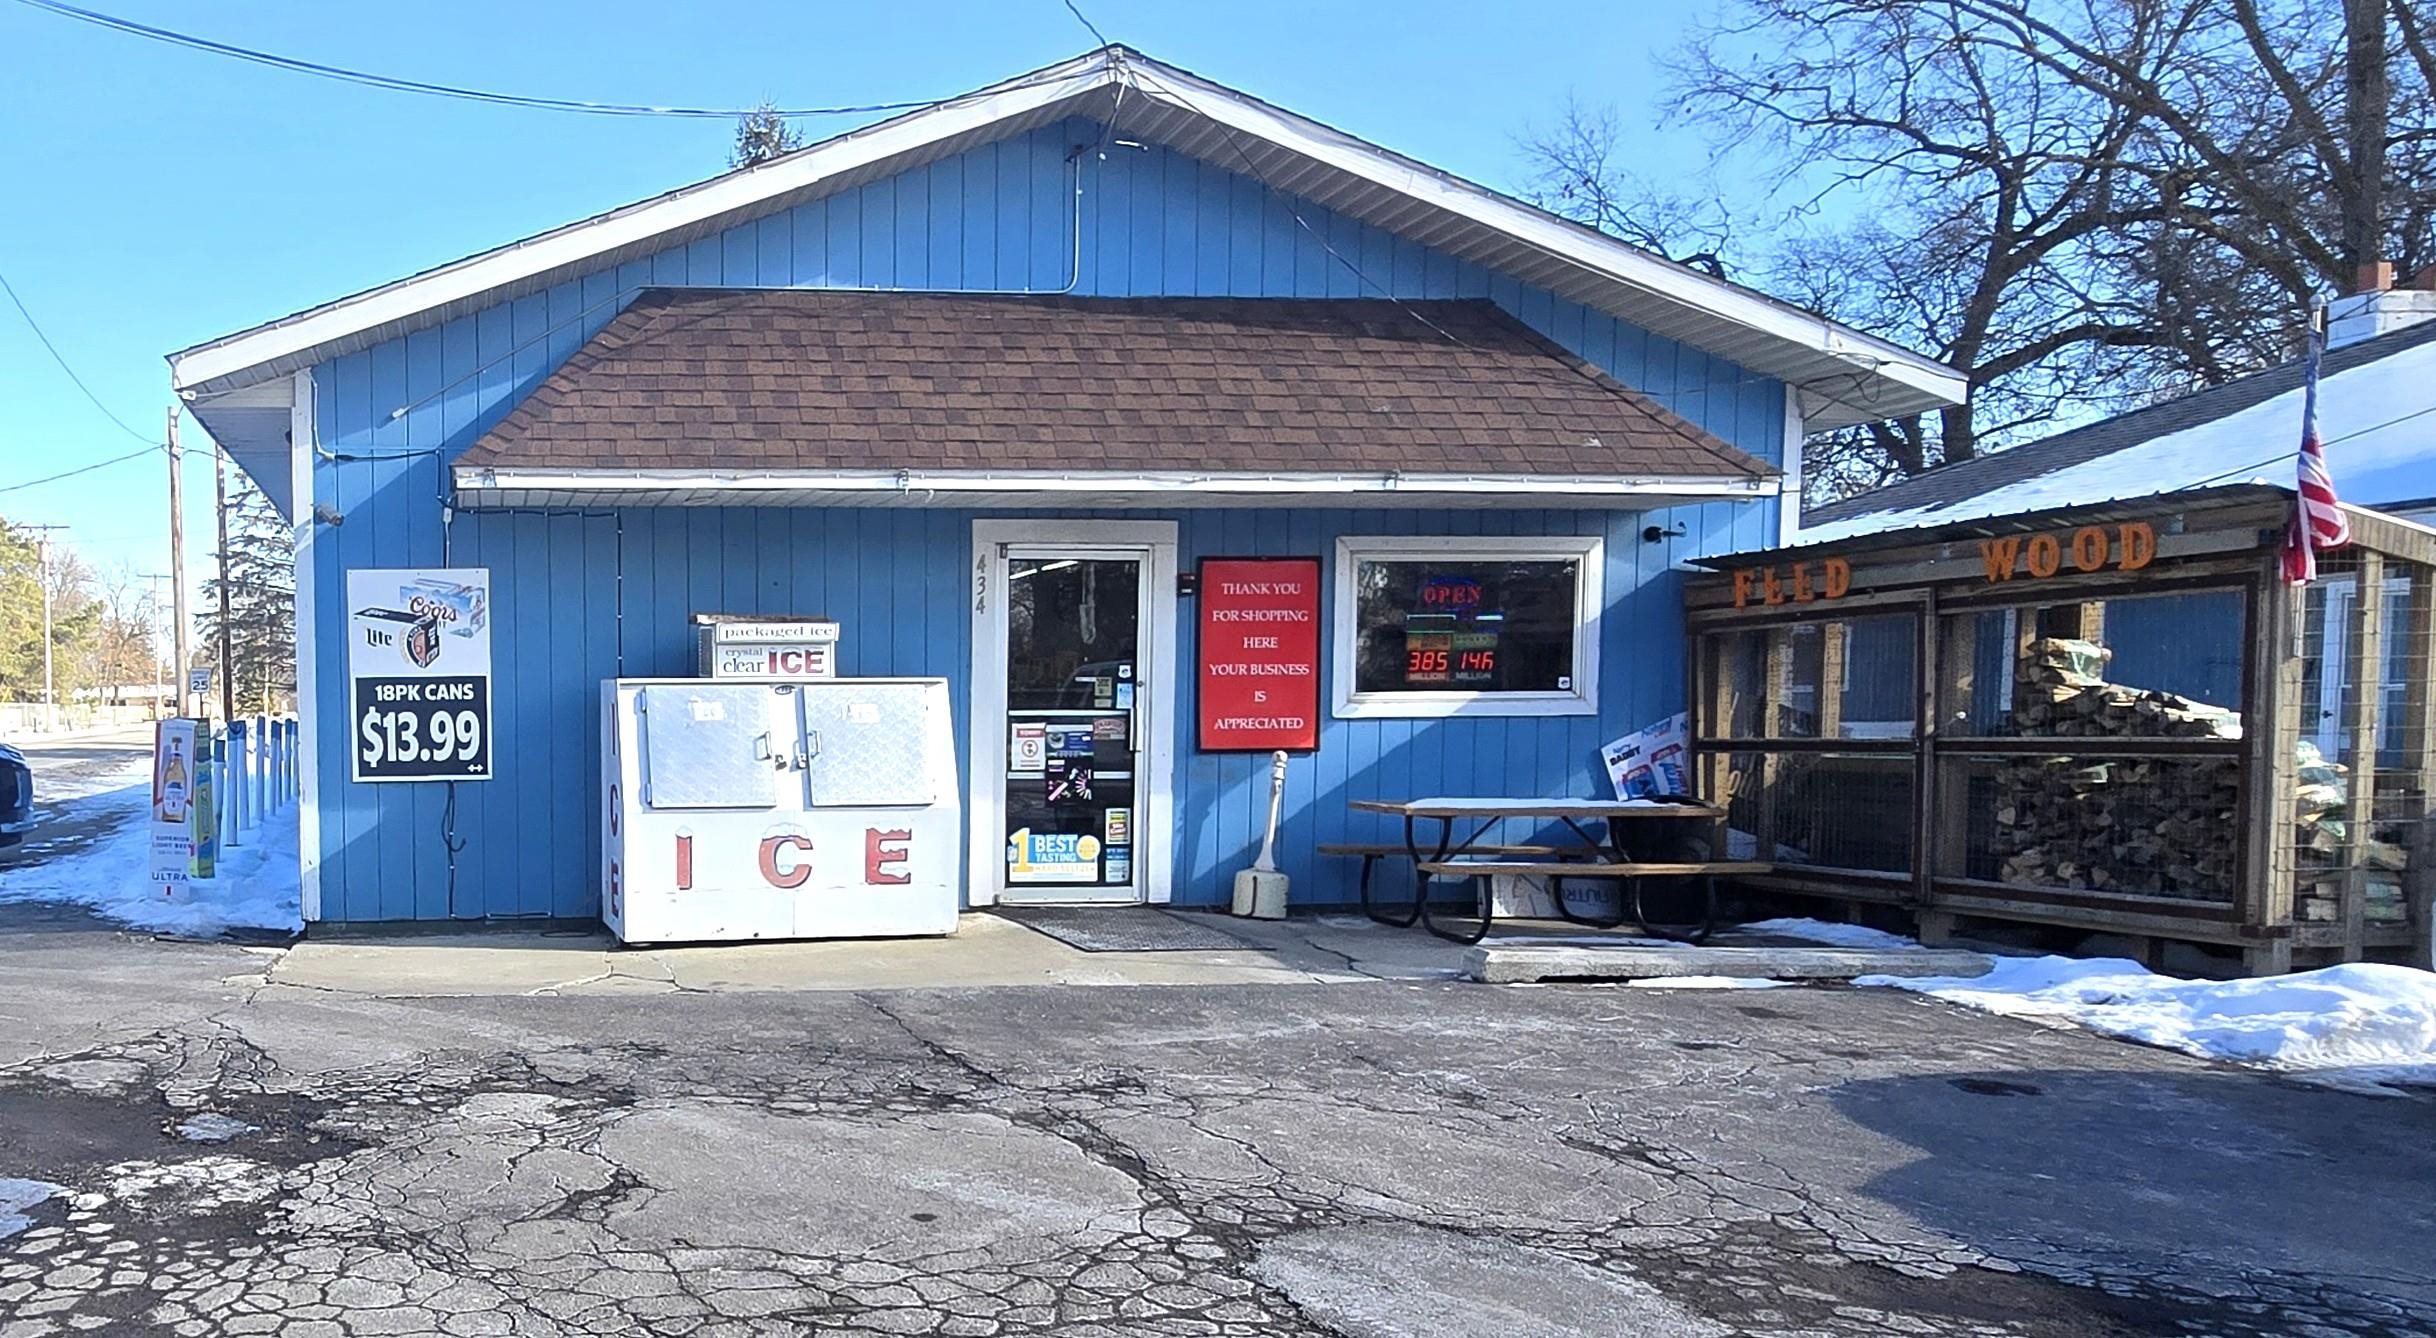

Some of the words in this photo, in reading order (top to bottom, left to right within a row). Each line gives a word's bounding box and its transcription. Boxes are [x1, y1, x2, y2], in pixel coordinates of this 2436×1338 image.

[1979, 521, 2157, 583] WOOD
[976, 554, 986, 614] 434
[1221, 583, 1271, 595] THANK
[1273, 583, 1301, 594] YOU
[1733, 556, 1851, 608] FEED
[1423, 586, 1482, 603] OPEN
[409, 596, 457, 622] Coors
[1213, 610, 1239, 622] FOR
[1241, 610, 1308, 622] SHOPPING
[367, 628, 393, 647] Lite
[725, 626, 804, 639] packaged
[810, 626, 833, 637] ice
[1243, 637, 1278, 649] HERE
[725, 648, 763, 659] crystal
[768, 647, 824, 674] ICE
[1408, 651, 1448, 671] 385
[723, 658, 764, 673] clear
[1209, 664, 1247, 676] YOUR
[1250, 664, 1310, 676] BUSINESS
[1408, 672, 1445, 681] MILLION
[1456, 672, 1492, 680] MILLION
[192, 680, 209, 690] 25
[375, 684, 421, 701] 18PK
[425, 684, 475, 700] CANS
[1254, 691, 1267, 703] IS
[1214, 717, 1304, 730] APPRECIATED
[362, 706, 480, 767] $13.99
[610, 703, 619, 919] ICE
[1035, 834, 1078, 853] BEST
[676, 823, 912, 889] ICE
[1036, 853, 1077, 862] TASTING
[152, 872, 189, 881] ULTRA
